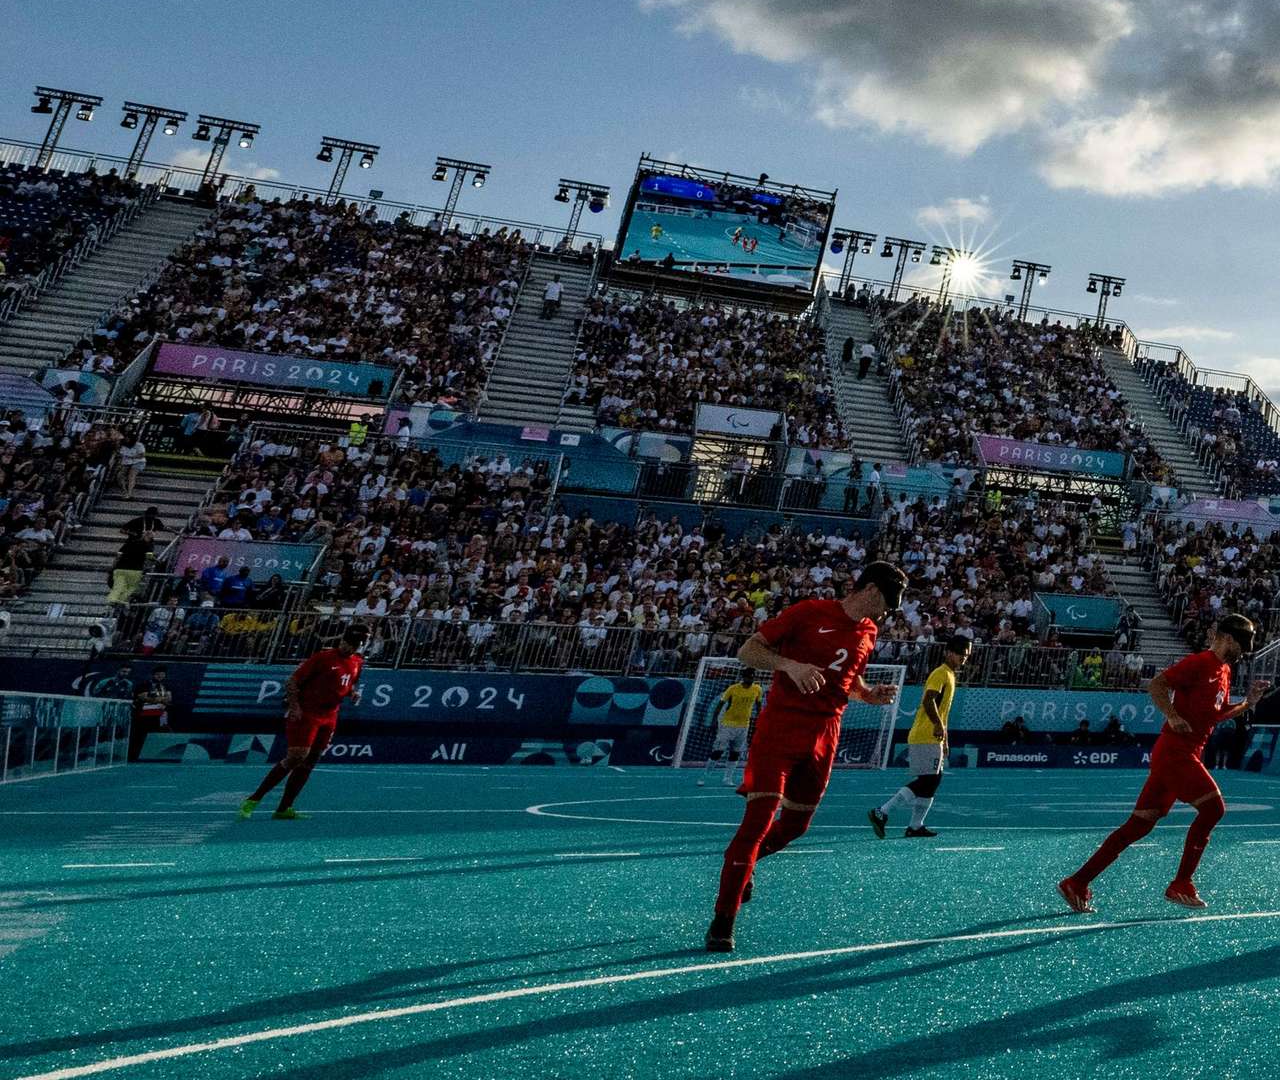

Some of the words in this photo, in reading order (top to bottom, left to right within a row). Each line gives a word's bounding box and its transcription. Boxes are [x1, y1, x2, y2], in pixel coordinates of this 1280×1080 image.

[191, 354, 276, 377] PARIS
[288, 365, 361, 387] 2024
[999, 445, 1051, 462] PARIS
[1059, 452, 1106, 469] 2024
[828, 648, 848, 671] 2
[256, 680, 393, 708] PIS
[411, 685, 526, 710] 2024
[1001, 701, 1089, 721] PARIS
[1100, 703, 1155, 722] 202
[321, 743, 375, 758] YOTA
[431, 743, 467, 761] All
[986, 751, 1049, 763] Panasonic
